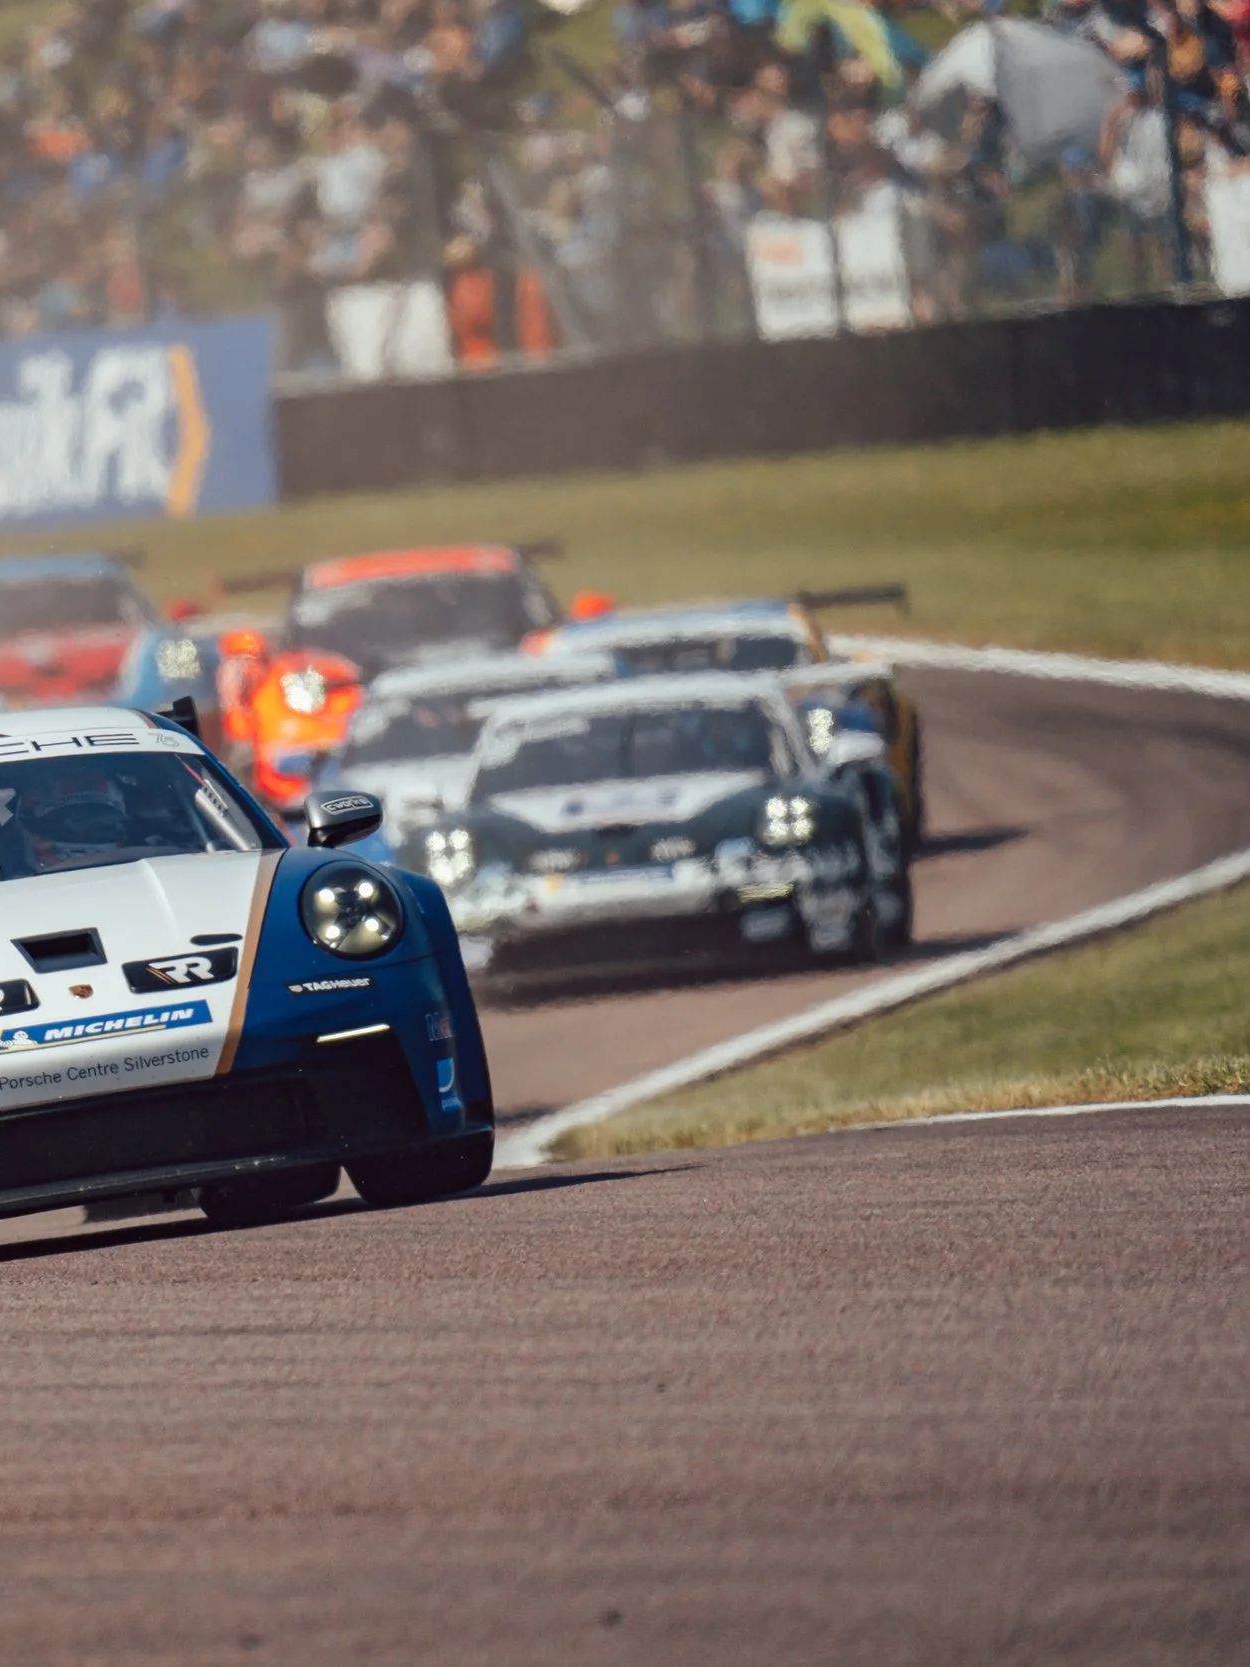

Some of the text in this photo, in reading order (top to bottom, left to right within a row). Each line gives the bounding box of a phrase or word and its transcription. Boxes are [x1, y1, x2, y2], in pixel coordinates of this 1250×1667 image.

[43, 1008, 195, 1041] MICHELIN
[66, 1061, 119, 1082] Centre
[124, 1046, 210, 1073] Silverstone
